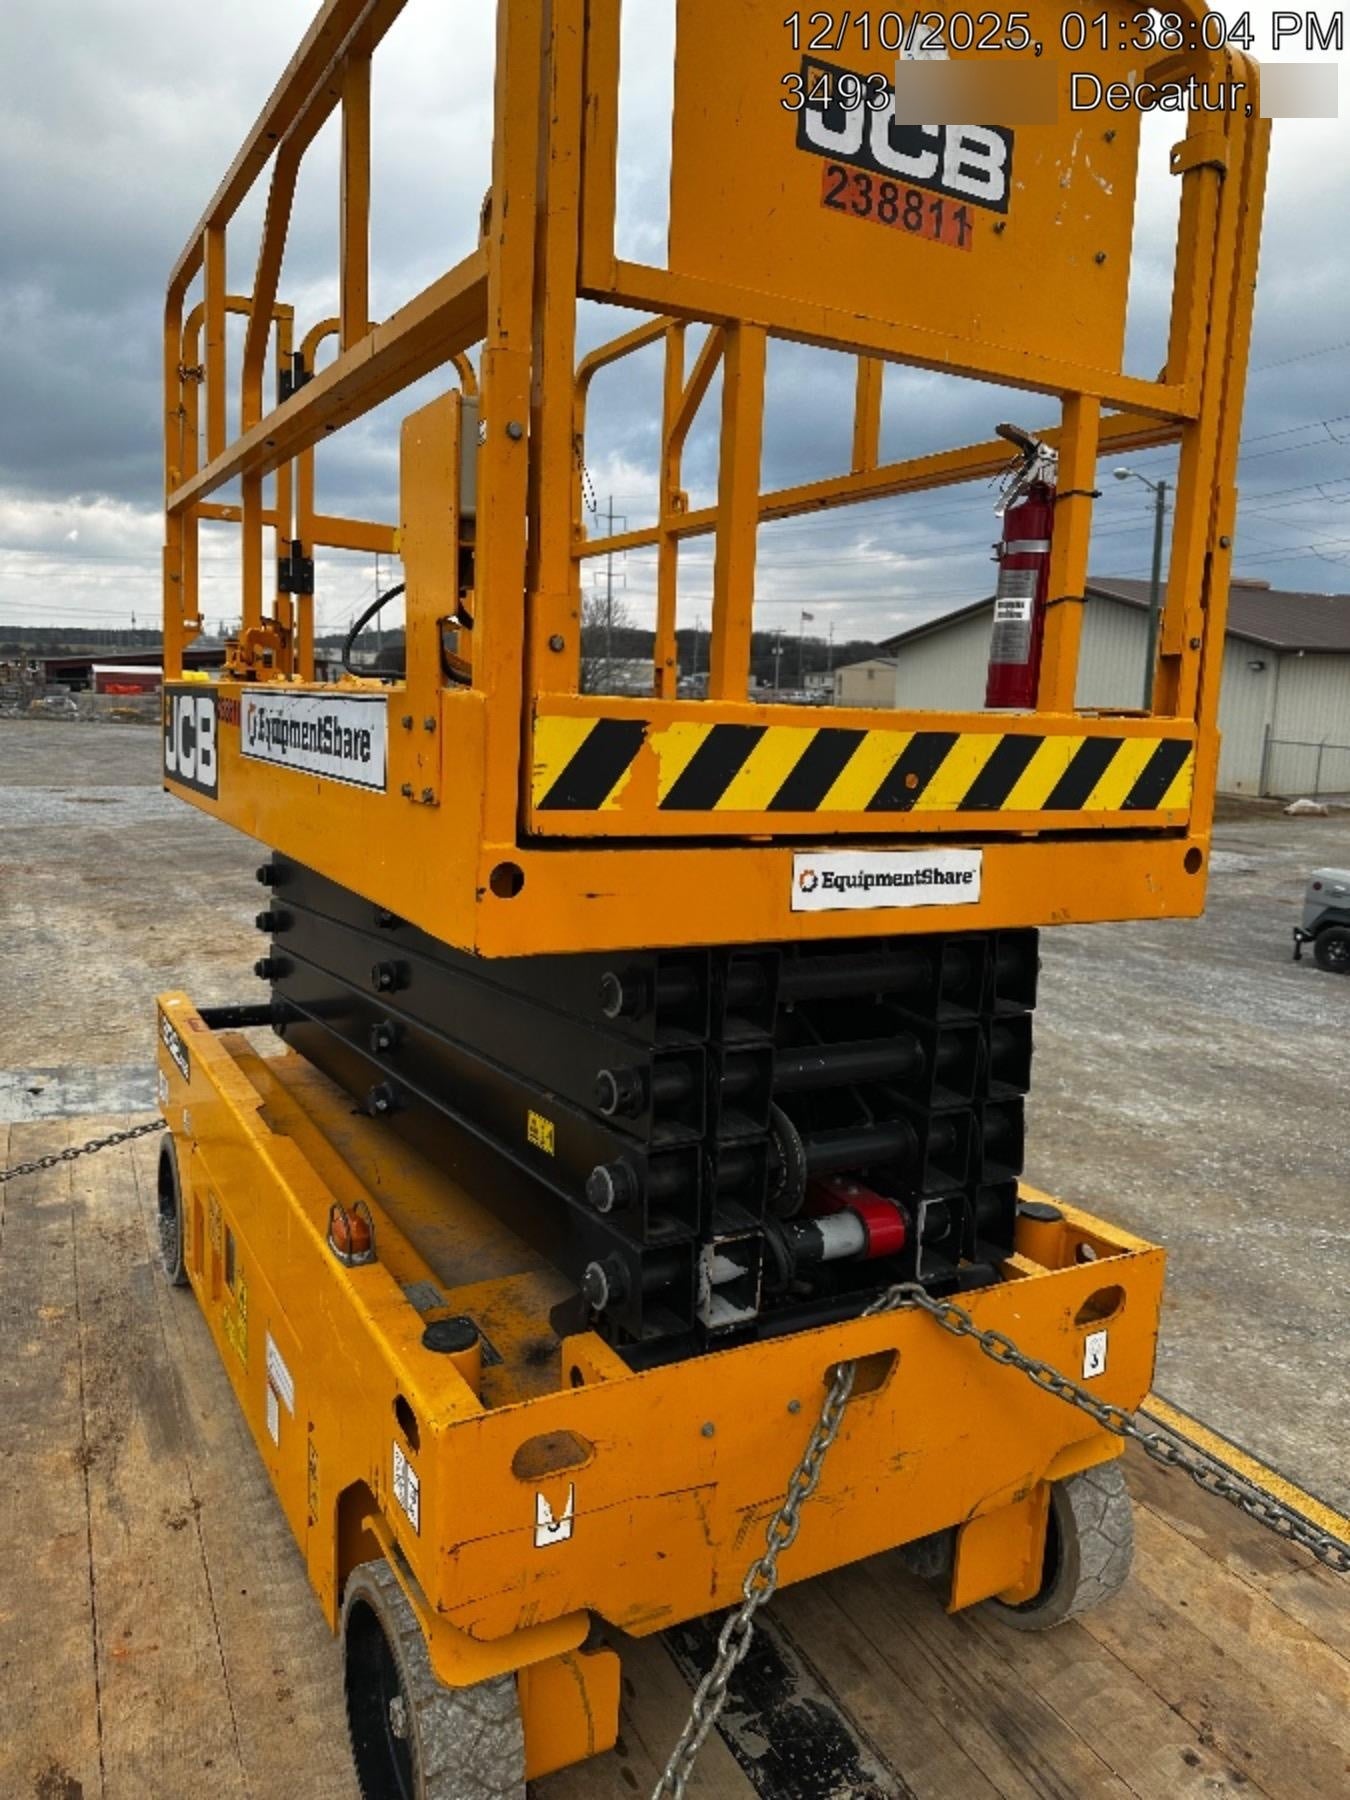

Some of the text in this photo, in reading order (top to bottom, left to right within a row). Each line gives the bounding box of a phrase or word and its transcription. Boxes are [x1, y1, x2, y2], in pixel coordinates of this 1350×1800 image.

[805, 77, 1007, 201] JCB
[823, 164, 971, 246] 238811
[165, 695, 216, 787] JCB
[257, 706, 372, 763] EquipmentShare
[821, 867, 974, 892] EquipmentShare
